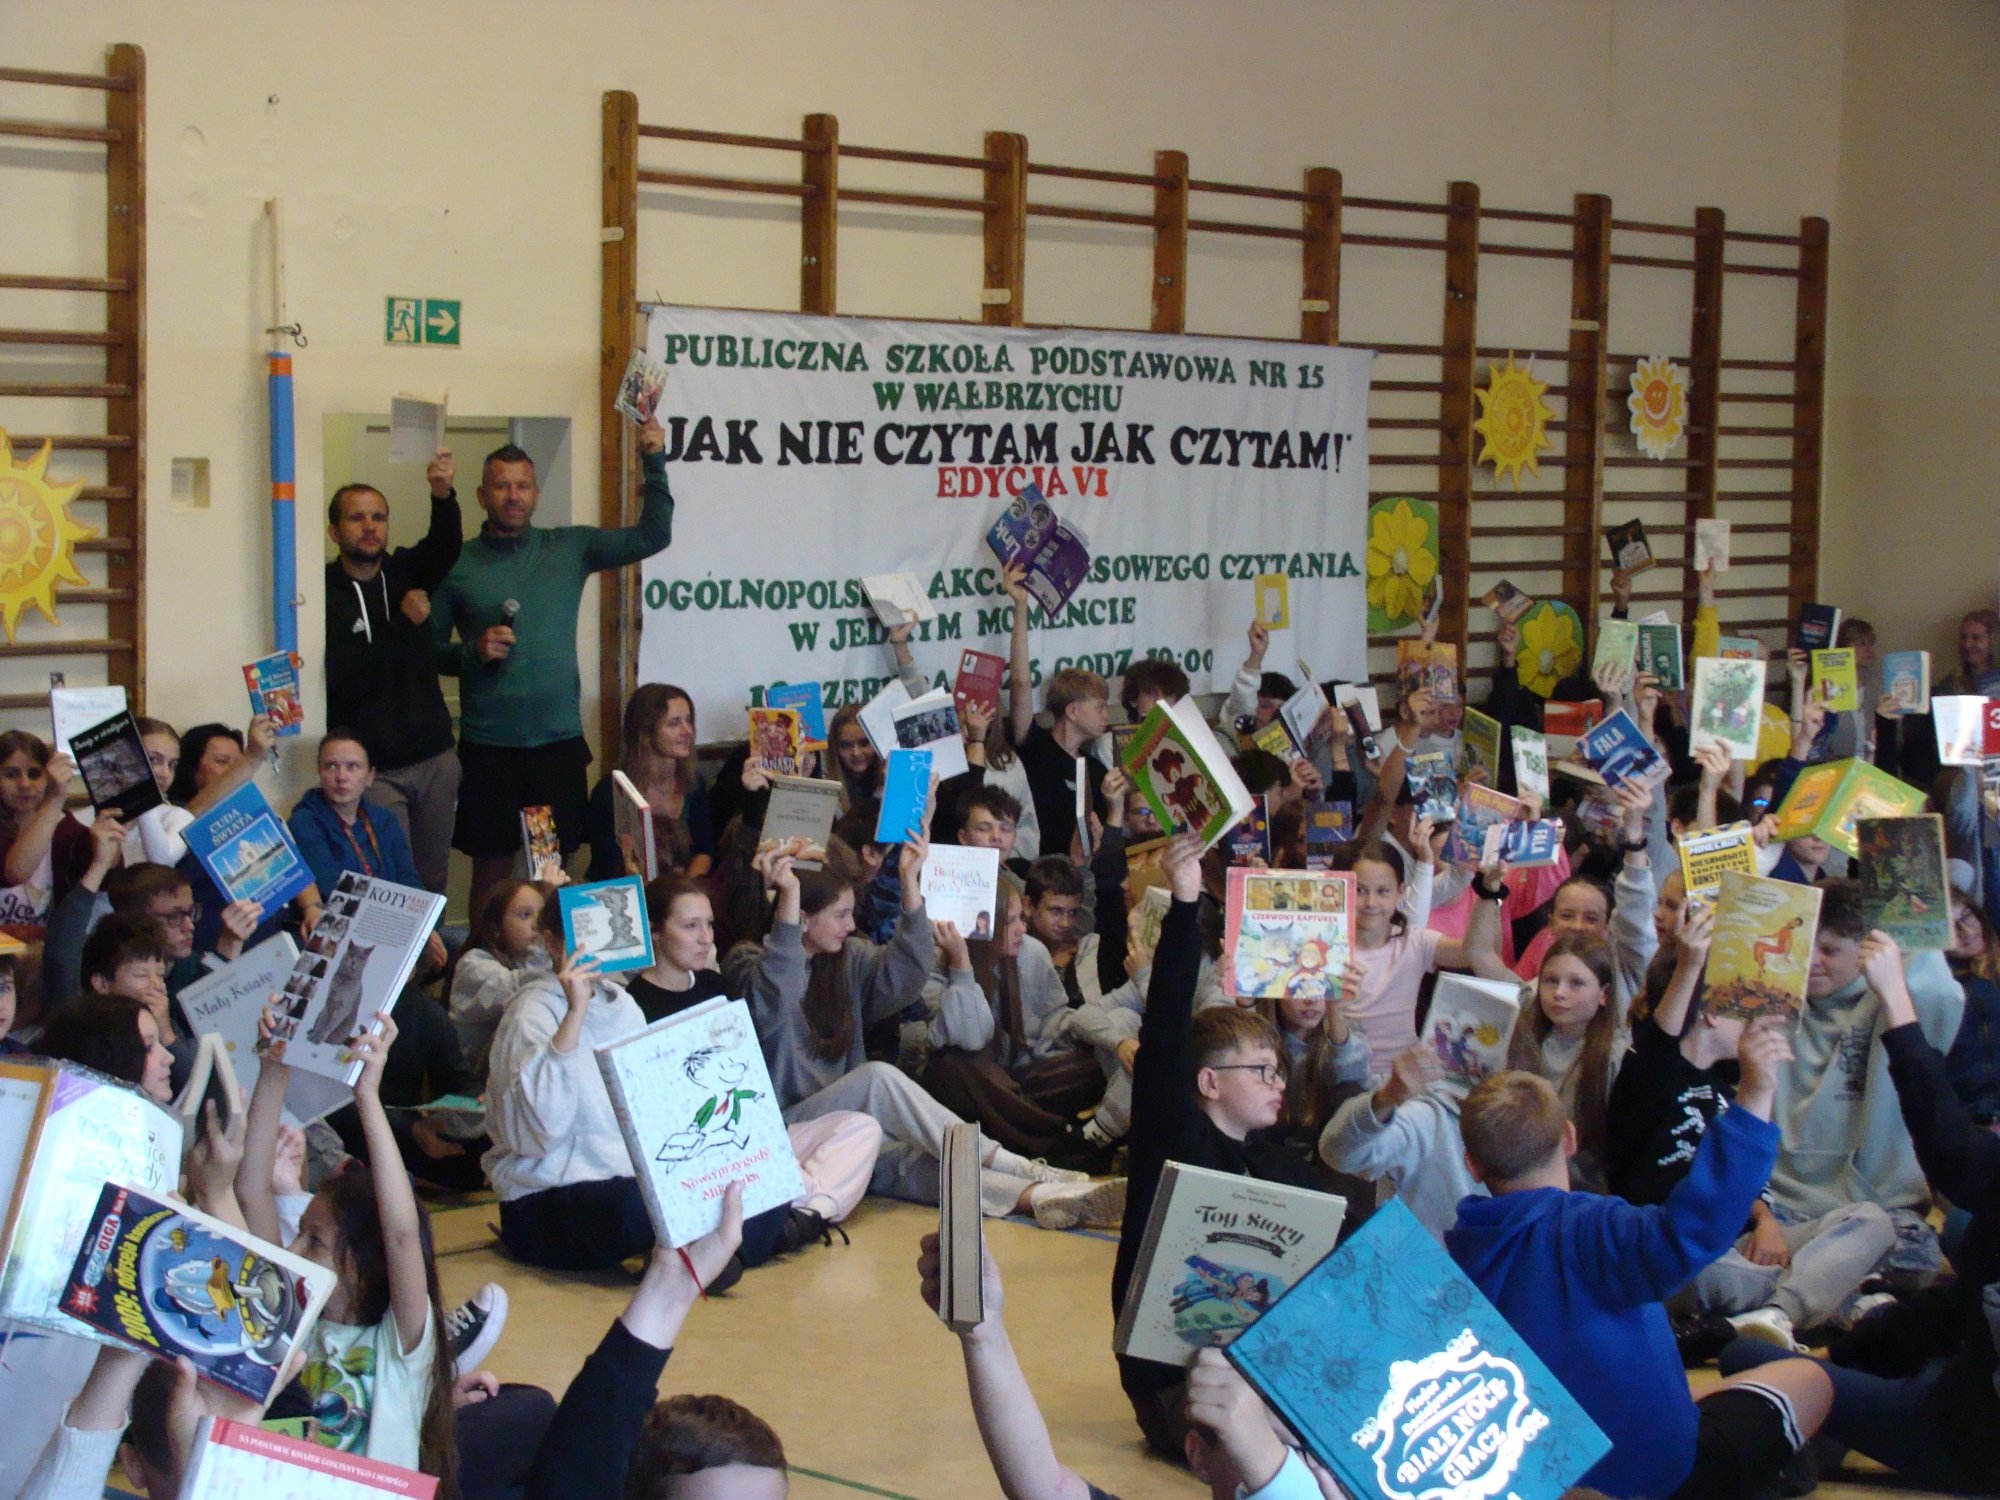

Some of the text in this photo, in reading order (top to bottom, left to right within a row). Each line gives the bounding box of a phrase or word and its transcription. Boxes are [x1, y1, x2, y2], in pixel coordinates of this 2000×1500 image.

[665, 334, 1325, 389] PUBLICZNA SZKOŁA PODSTAWOWA NR 15
[873, 381, 1123, 413] W WAŁBRZYCHU
[666, 416, 763, 465] JAK
[778, 421, 864, 466] NIE
[873, 421, 1058, 466] CZYTAM
[1070, 421, 1156, 464] JAK
[1072, 467, 1109, 497] VI
[1219, 551, 1361, 580] CZYTANIA
[788, 622, 820, 652] W
[1593, 726, 1626, 757] FALA
[207, 808, 242, 836] CUDA
[210, 811, 255, 847] ŚWIATA
[1530, 828, 1549, 853] FALA
[368, 885, 411, 909] KOTY
[98, 1215, 120, 1252] GIGA
[1194, 1203, 1307, 1248] Toy Story
[113, 1289, 160, 1347] 2009:
[1395, 1374, 1513, 1487] BIAŁE NOCE
[1440, 1421, 1509, 1488] GRACZ
